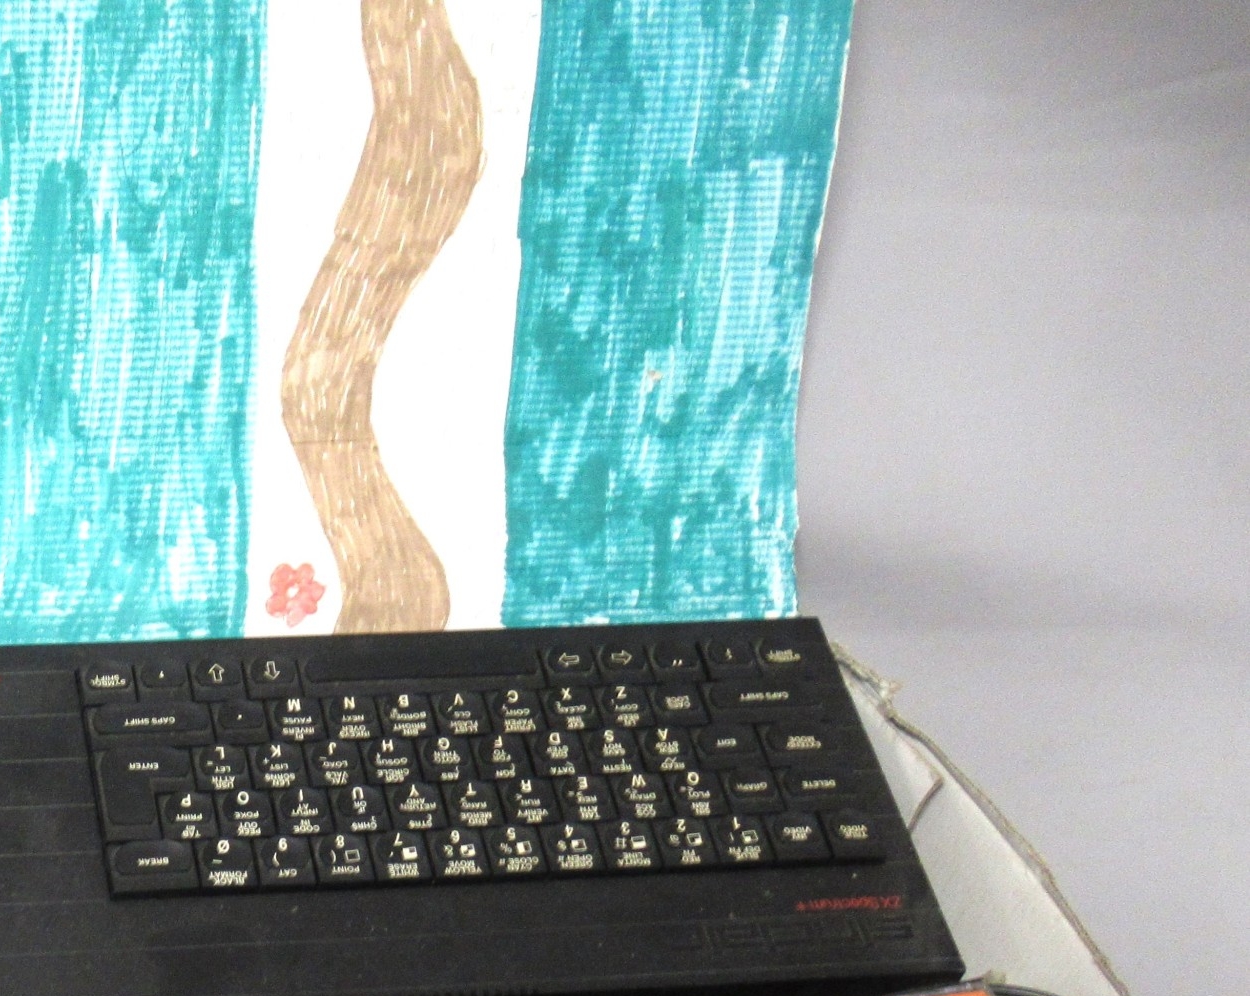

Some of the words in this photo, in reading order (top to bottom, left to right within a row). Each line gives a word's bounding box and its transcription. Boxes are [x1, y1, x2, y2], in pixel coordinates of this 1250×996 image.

[454, 693, 463, 705] V
[507, 690, 519, 703] C
[561, 687, 572, 700] X
[616, 686, 627, 700] Z
[287, 698, 301, 711] M
[344, 697, 355, 709] N
[398, 694, 409, 708] B
[550, 732, 560, 744] D
[604, 730, 614, 742] S
[657, 728, 668, 739] A
[329, 742, 336, 754] J
[382, 740, 393, 752] H
[438, 738, 450, 750] G
[494, 736, 502, 748] F
[216, 746, 224, 758] L
[270, 745, 281, 756] K
[129, 762, 158, 770] ENTER
[578, 776, 588, 789] E
[632, 774, 645, 786] W
[687, 771, 699, 784] Q
[409, 784, 419, 796] Y
[464, 783, 476, 795] T
[520, 780, 532, 792] R
[237, 792, 249, 804] O
[298, 789, 303, 800] I
[352, 787, 363, 799] U
[181, 794, 192, 806] P
[621, 822, 630, 834] 3
[676, 820, 686, 832] 2
[733, 817, 740, 830] 1
[450, 830, 460, 842] 6
[507, 827, 516, 840] 5
[564, 824, 574, 837] 4
[278, 838, 287, 851] 9
[336, 835, 344, 848] 8
[393, 832, 403, 846] 7
[138, 857, 169, 866] BREAK
